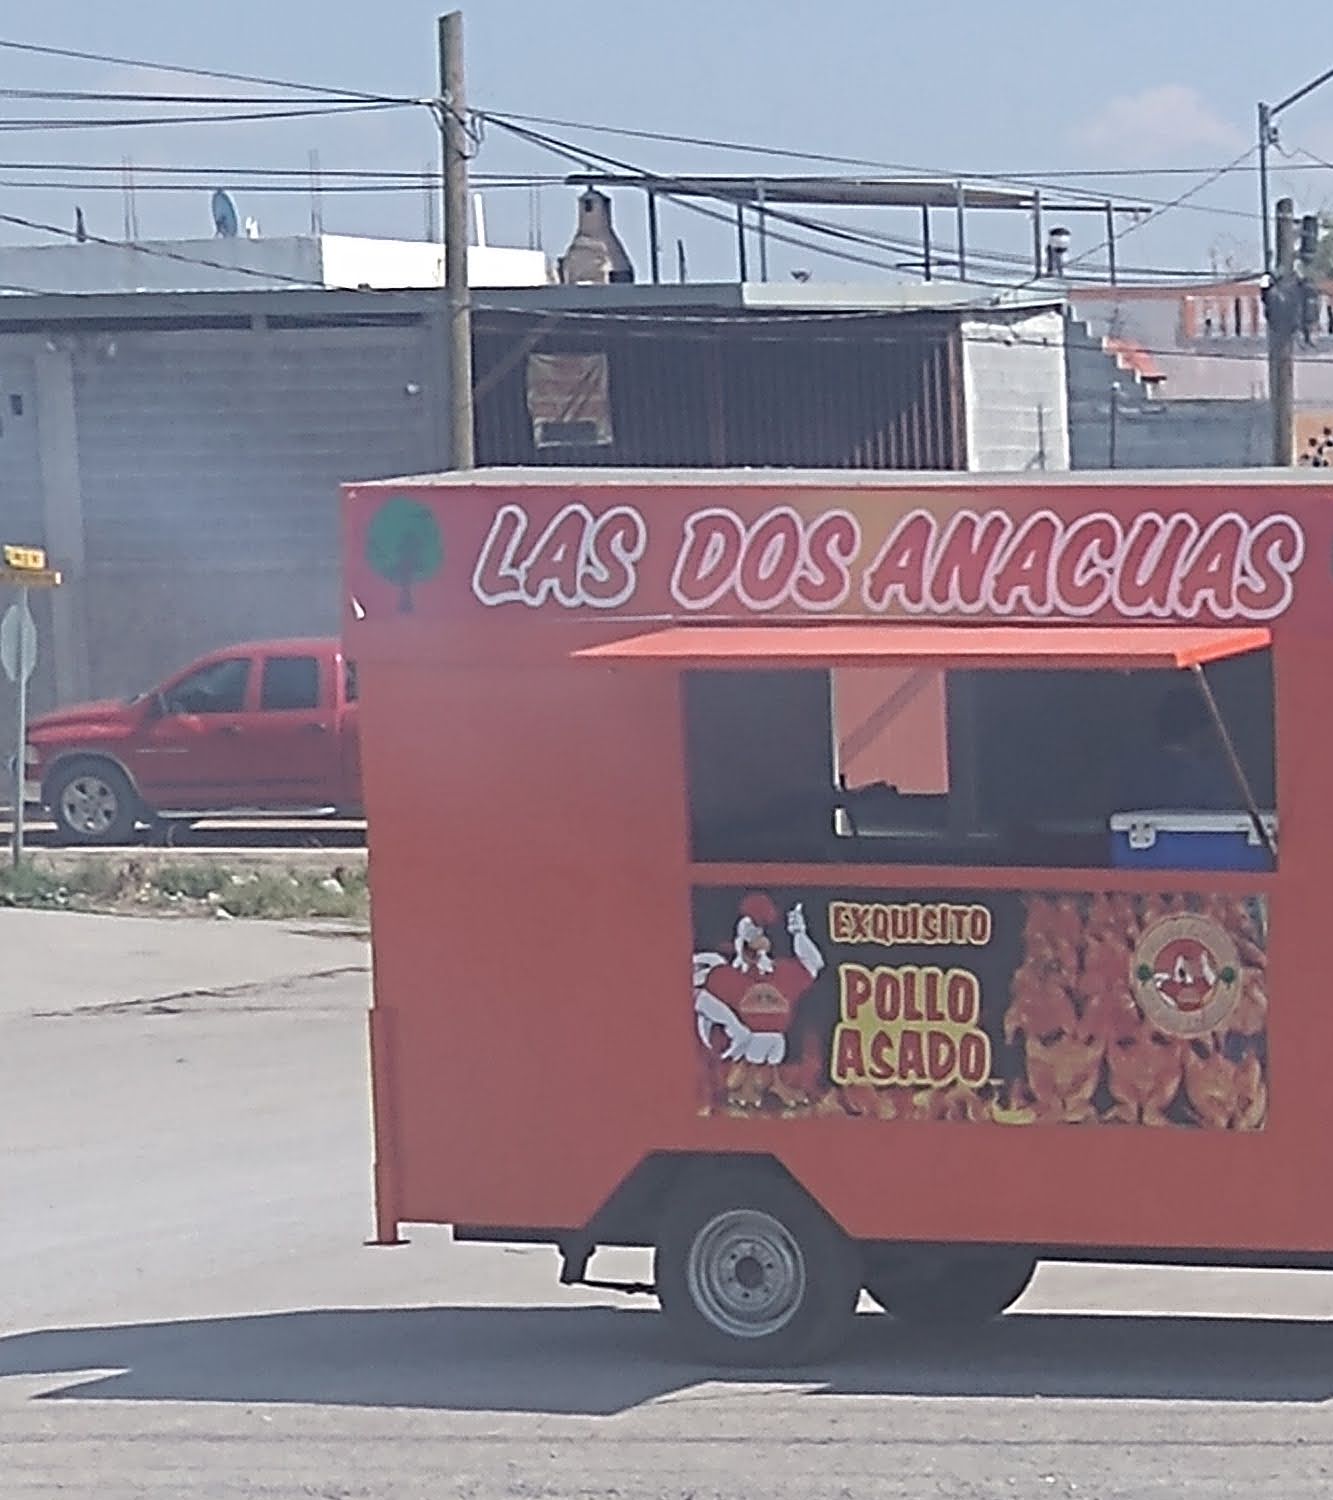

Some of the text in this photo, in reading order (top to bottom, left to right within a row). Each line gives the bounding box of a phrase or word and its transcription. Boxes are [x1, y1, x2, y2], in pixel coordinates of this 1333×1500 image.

[473, 504, 1304, 619] LAS DOS ANACUAS
[831, 903, 990, 944] EXQUISITO
[841, 964, 978, 1024] POLLO
[833, 1025, 990, 1086] ASADO
